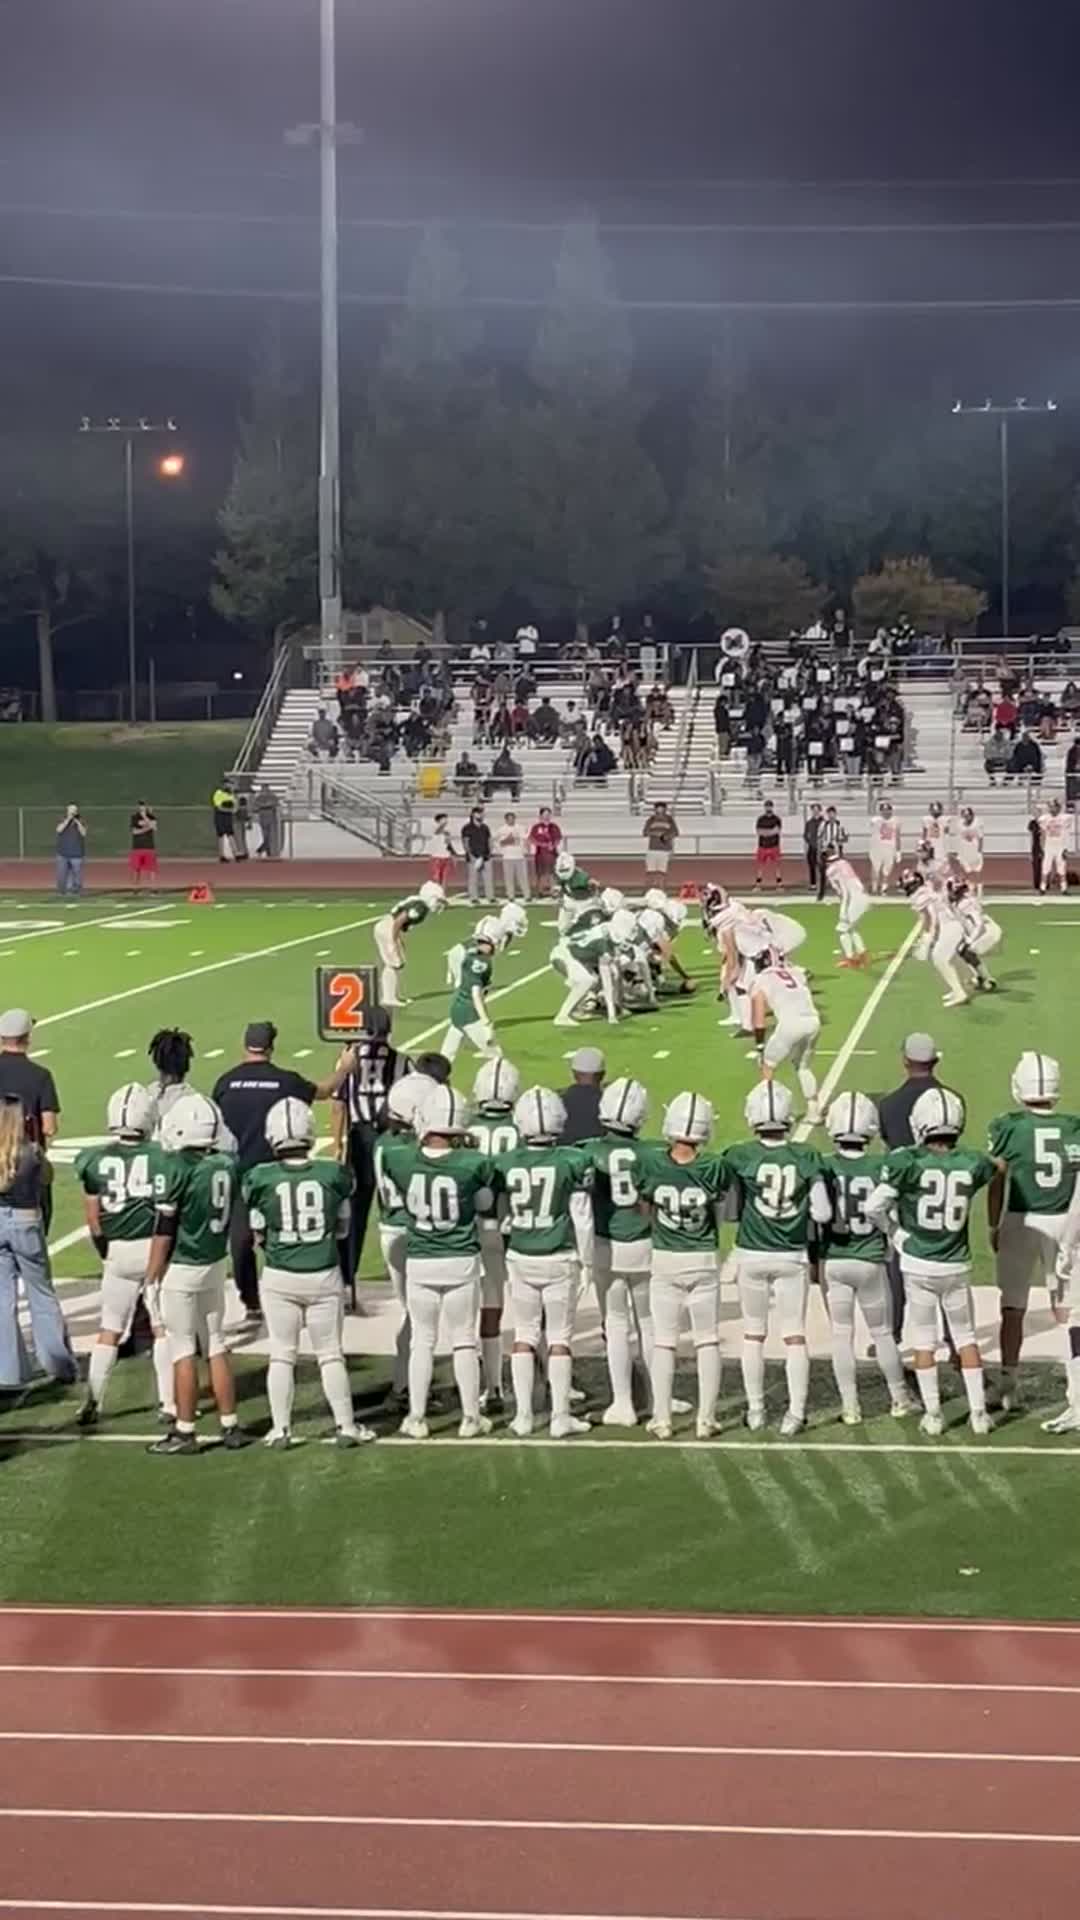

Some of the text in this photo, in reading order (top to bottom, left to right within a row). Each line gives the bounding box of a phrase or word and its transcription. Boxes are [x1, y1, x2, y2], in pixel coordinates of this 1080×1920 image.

[329, 973, 364, 1028] 2
[98, 1154, 152, 1213] 34
[154, 1174, 165, 1194] 9
[609, 1148, 638, 1206] 6
[1035, 1128, 1061, 1188] 5
[210, 1170, 231, 1233] 9
[275, 1181, 325, 1242] 18
[406, 1173, 459, 1231] 40
[506, 1166, 556, 1229] 27
[755, 1163, 799, 1218] 31
[832, 1175, 876, 1235] 13
[917, 1168, 973, 1232] 26
